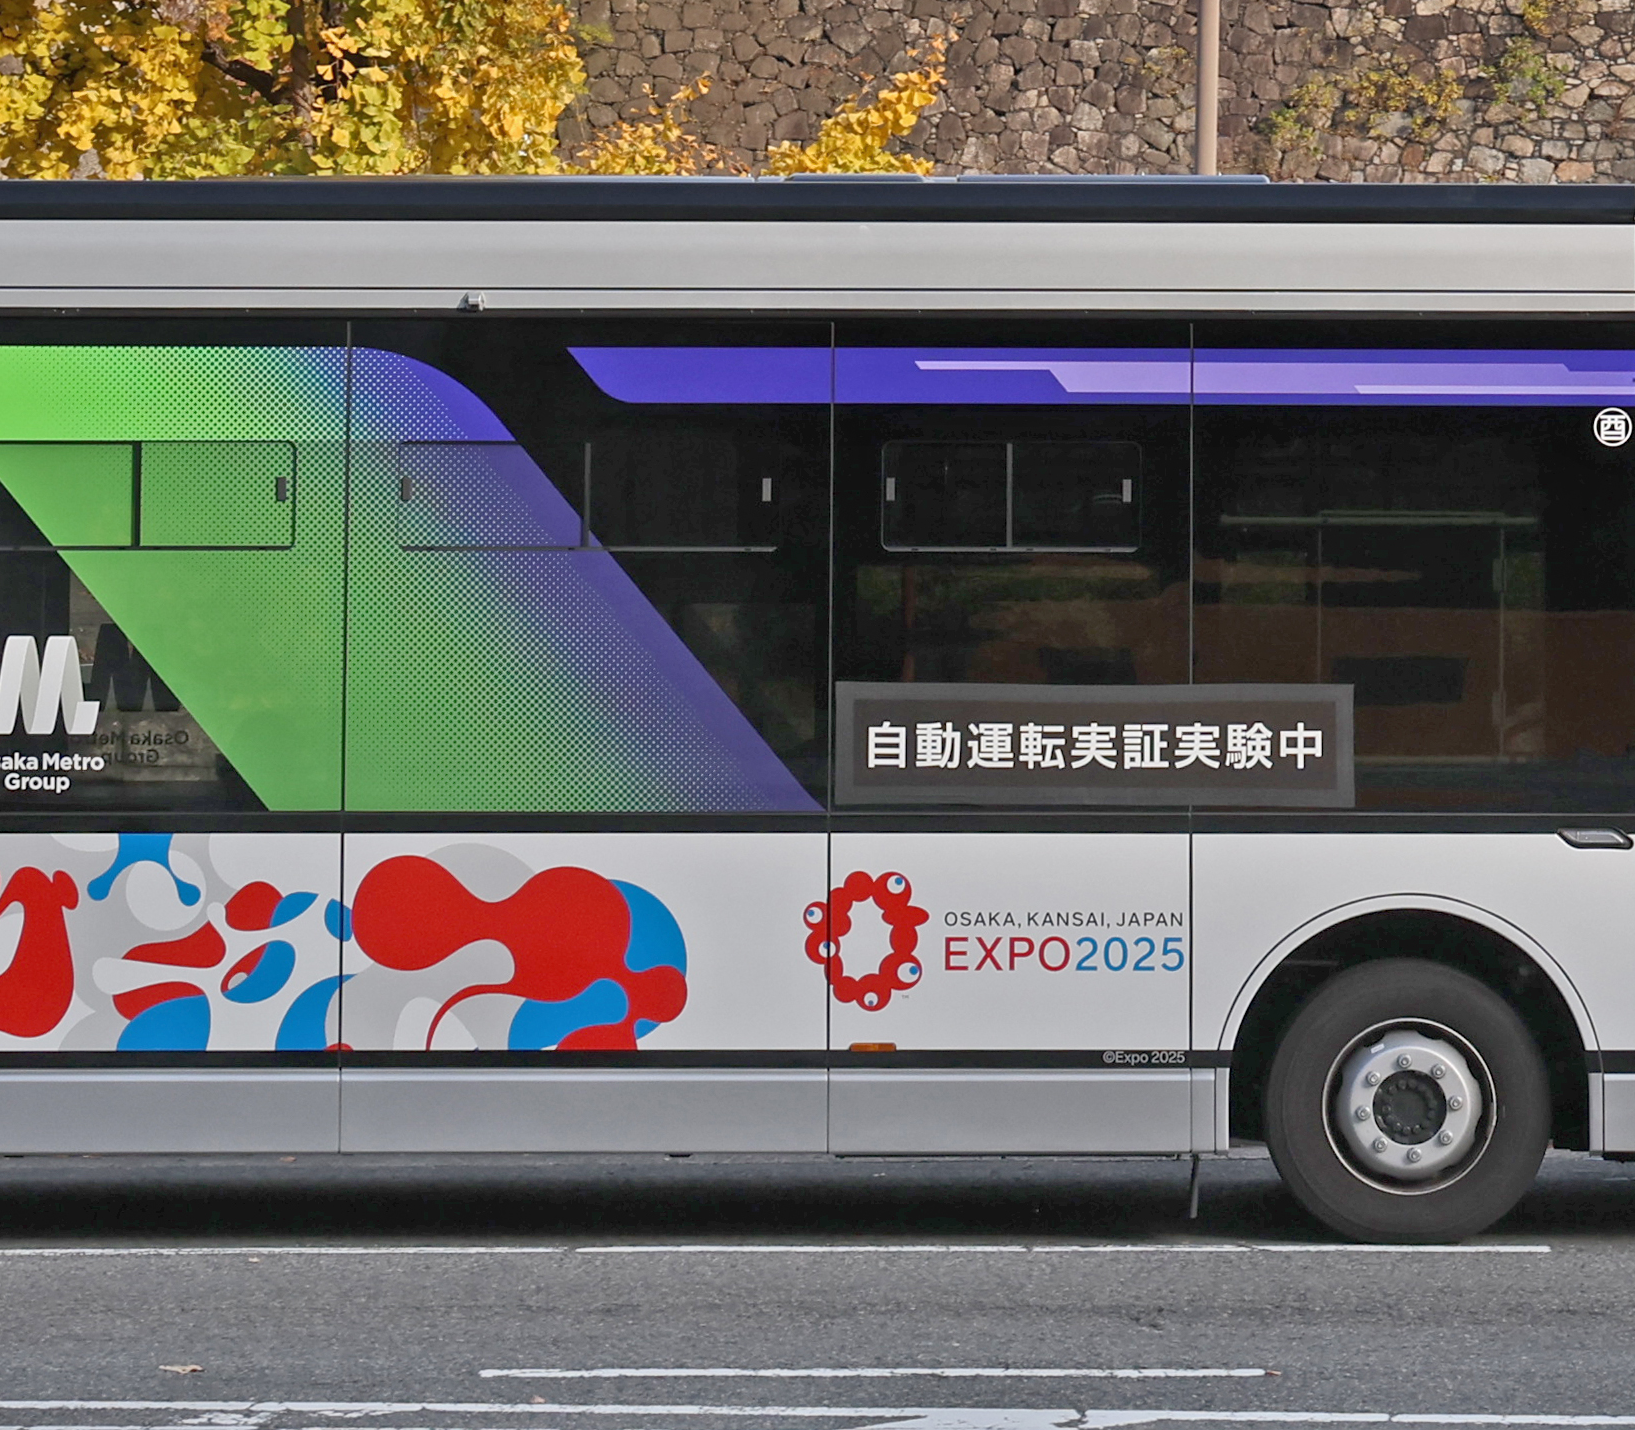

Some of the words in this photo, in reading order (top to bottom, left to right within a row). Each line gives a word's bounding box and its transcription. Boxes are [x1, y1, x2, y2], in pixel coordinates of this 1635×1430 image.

[867, 722, 1323, 769] 自動運転実証実験中
[43, 752, 105, 771] Metro
[4, 772, 70, 794] Group
[944, 911, 1021, 930] OSAKA,
[1027, 911, 1111, 930] KANSAI,
[1116, 911, 1183, 928] JAPAN
[945, 937, 1185, 972] EXPO2025
[1151, 1051, 1186, 1063] 2025
